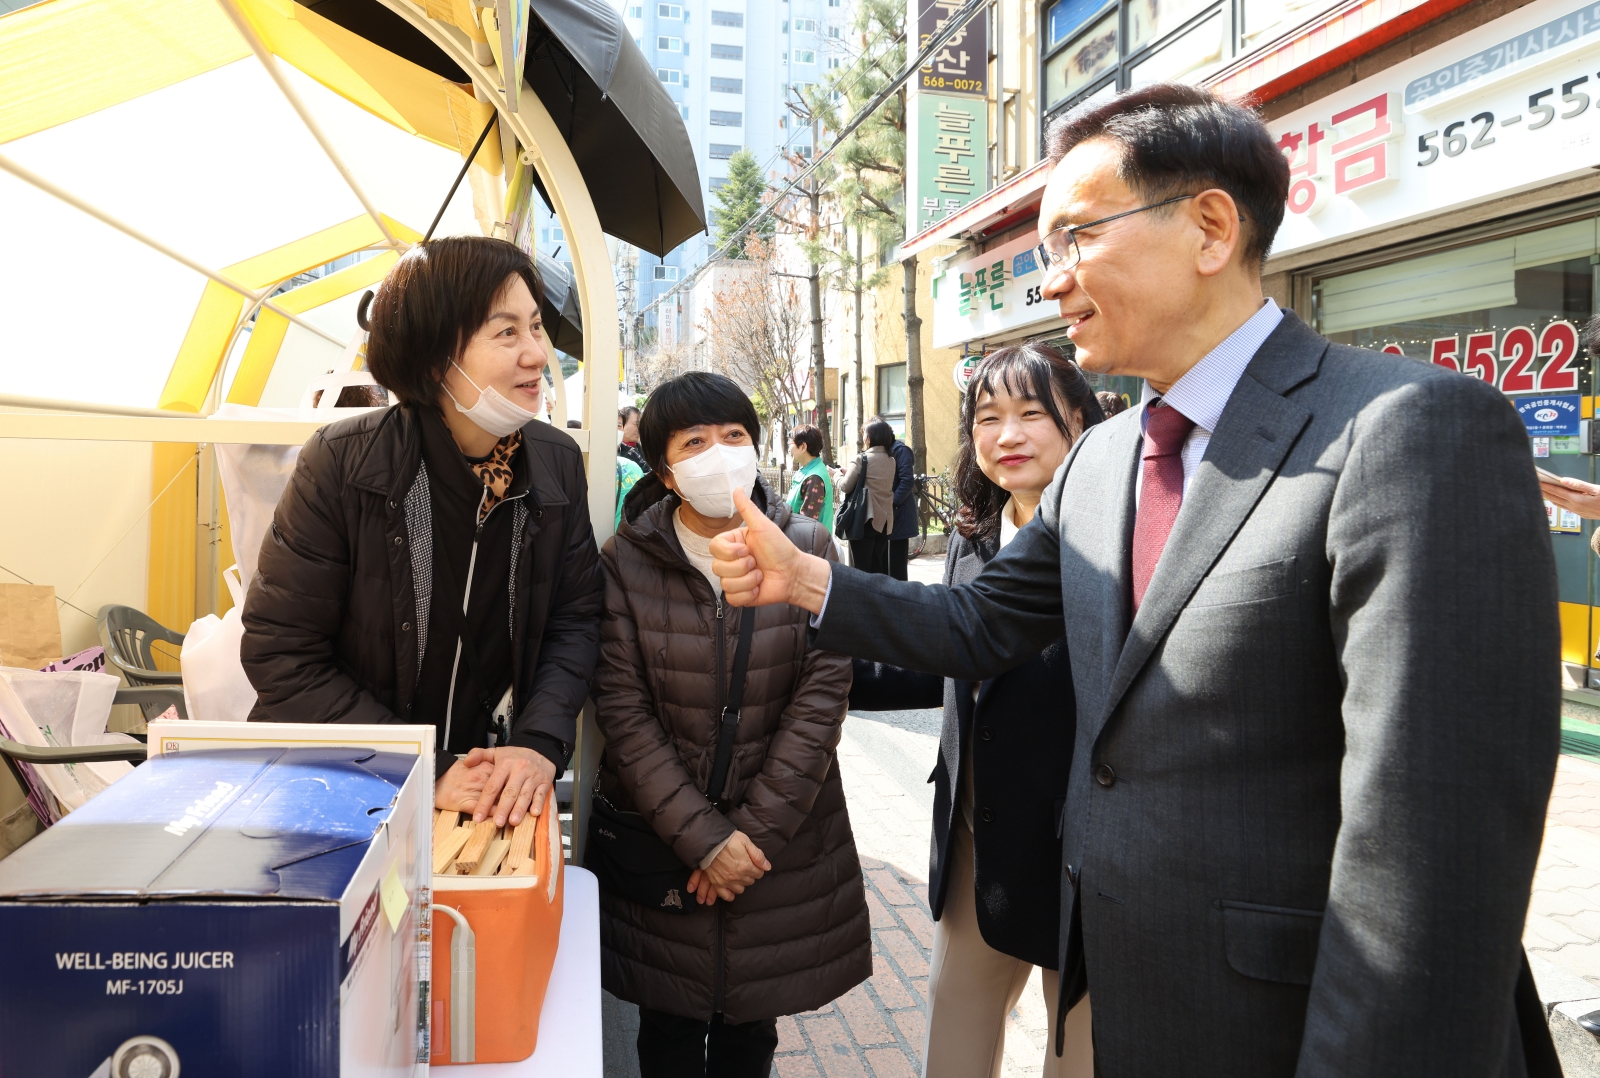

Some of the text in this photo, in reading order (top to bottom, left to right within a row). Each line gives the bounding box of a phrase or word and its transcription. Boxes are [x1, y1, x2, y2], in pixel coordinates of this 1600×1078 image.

[923, 76, 983, 92] 568-0072
[1417, 70, 1600, 167] 562-55
[933, 102, 975, 195] 늘푸른
[1277, 93, 1391, 214] 황금
[959, 260, 1005, 317] 늘푸른
[55, 951, 234, 970] WELL-BEING JUICER
[106, 979, 183, 995] MF-1705J
